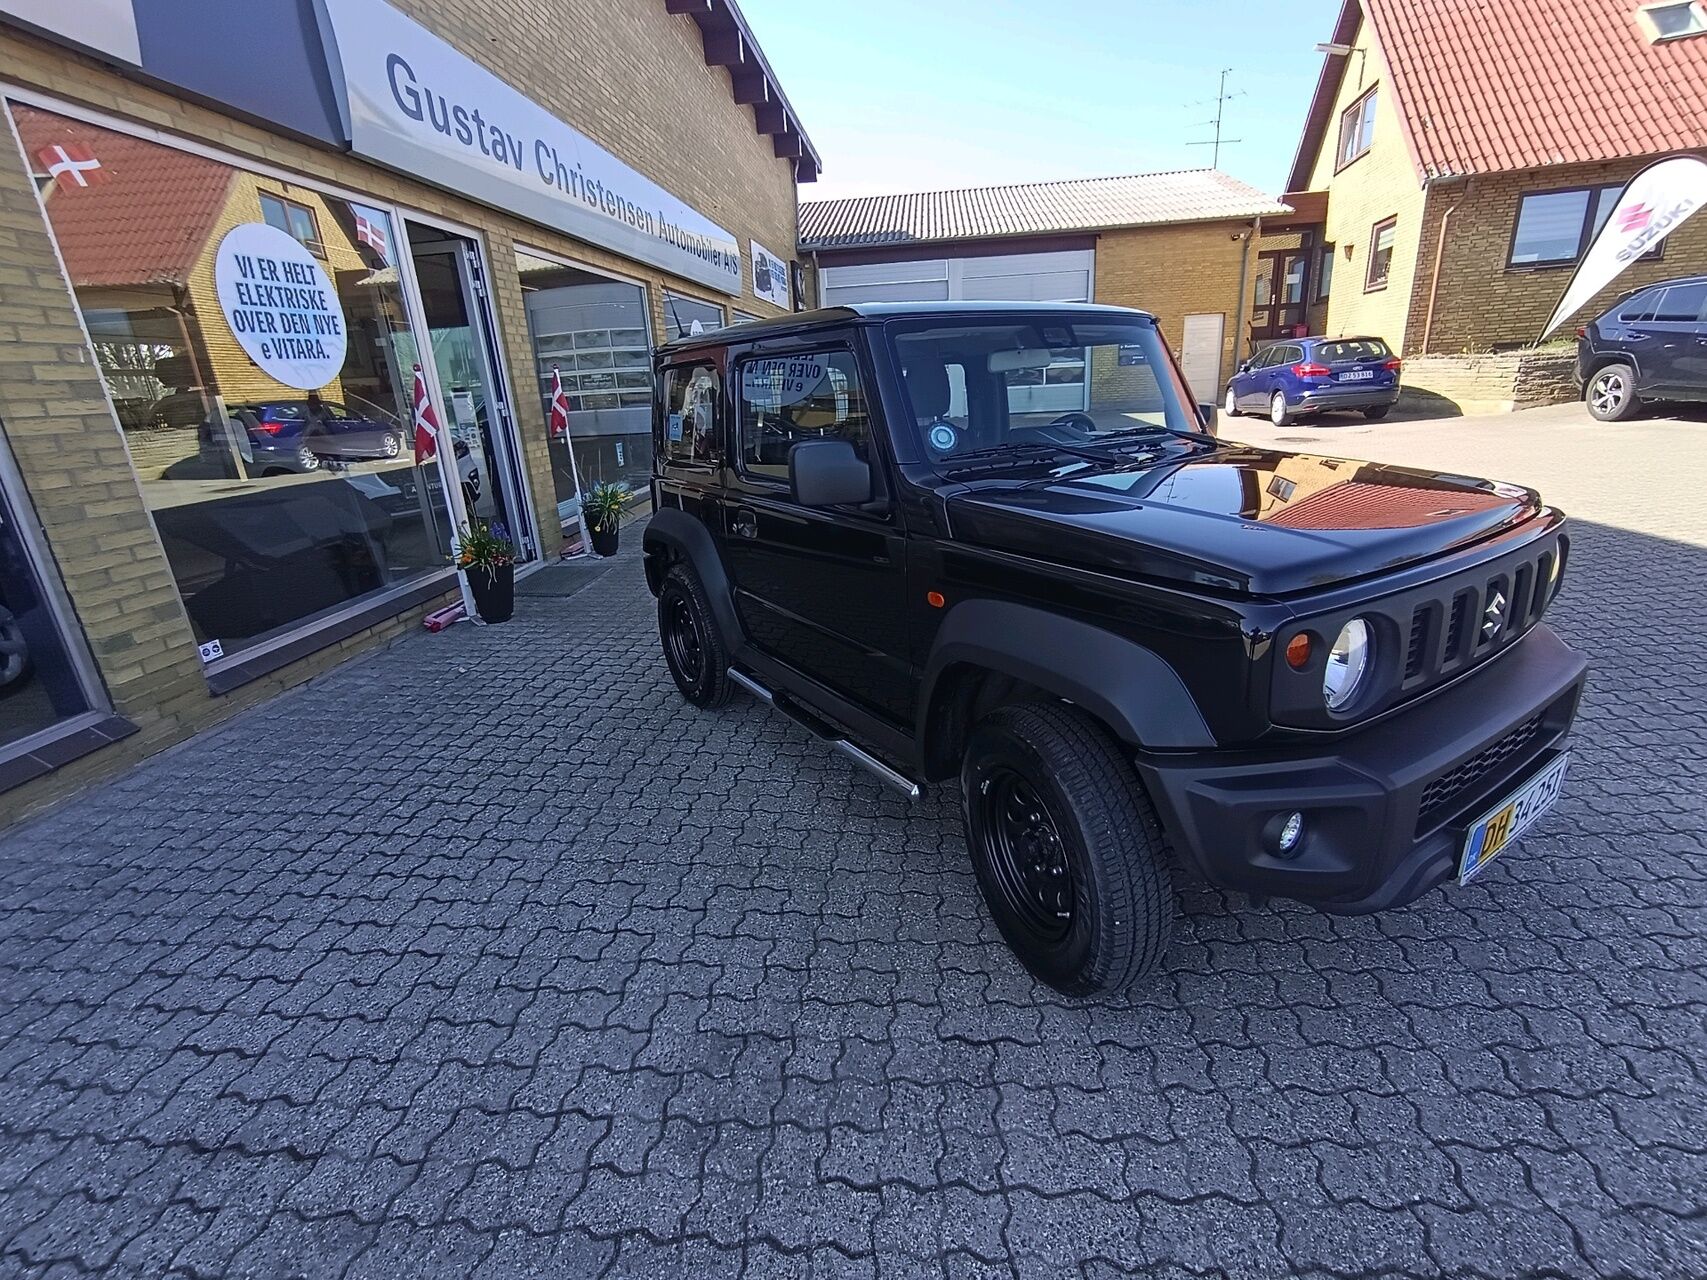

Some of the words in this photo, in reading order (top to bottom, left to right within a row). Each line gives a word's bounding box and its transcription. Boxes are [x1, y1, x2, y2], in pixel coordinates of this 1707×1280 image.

[386, 52, 522, 171] Gustav
[535, 138, 654, 235] Christensen
[658, 210, 721, 267] Automobiler
[724, 248, 738, 275] A/S
[1616, 198, 1694, 262] SUZUKI
[234, 254, 255, 279] VI
[257, 257, 280, 282] ER
[281, 261, 316, 286] HELT
[235, 282, 328, 311] ELEKTRISKE
[232, 309, 278, 333] OVER
[279, 312, 311, 335] DEN
[312, 314, 341, 335] NYE
[261, 342, 272, 359] e
[271, 337, 331, 360] VITARA.
[1480, 809, 1511, 857] DH
[1508, 790, 1535, 834] 34
[1532, 766, 1563, 814] 251
